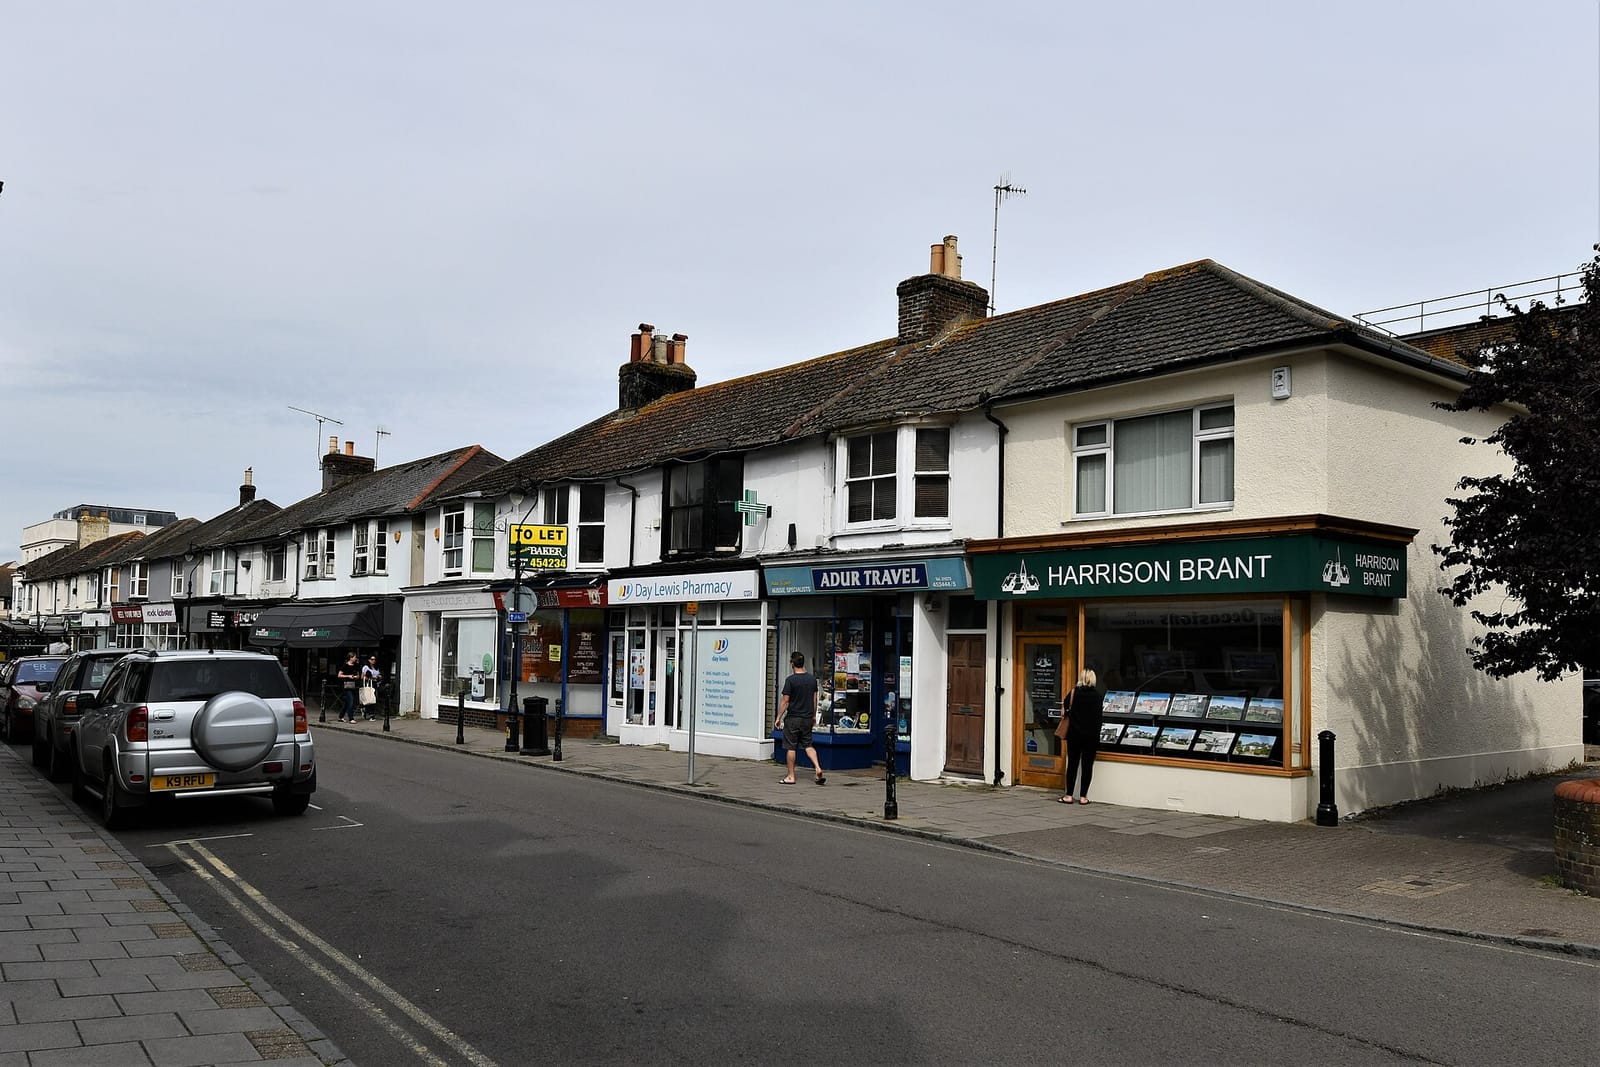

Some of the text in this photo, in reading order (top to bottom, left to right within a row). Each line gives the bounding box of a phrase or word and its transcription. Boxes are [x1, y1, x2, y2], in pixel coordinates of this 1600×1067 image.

[515, 529, 564, 540] TO LET
[529, 546, 567, 558] BAKER
[530, 558, 567, 568] 454234
[1355, 553, 1399, 571] HARRISON
[820, 568, 920, 587] ADUR TRAVEL
[1048, 554, 1273, 586] HARRISON BRANT
[1363, 572, 1392, 587] BRANT
[635, 583, 653, 600] Day
[654, 581, 680, 597] Lewis
[682, 579, 732, 597] Pharmacy
[166, 775, 205, 787] K9 RFU
